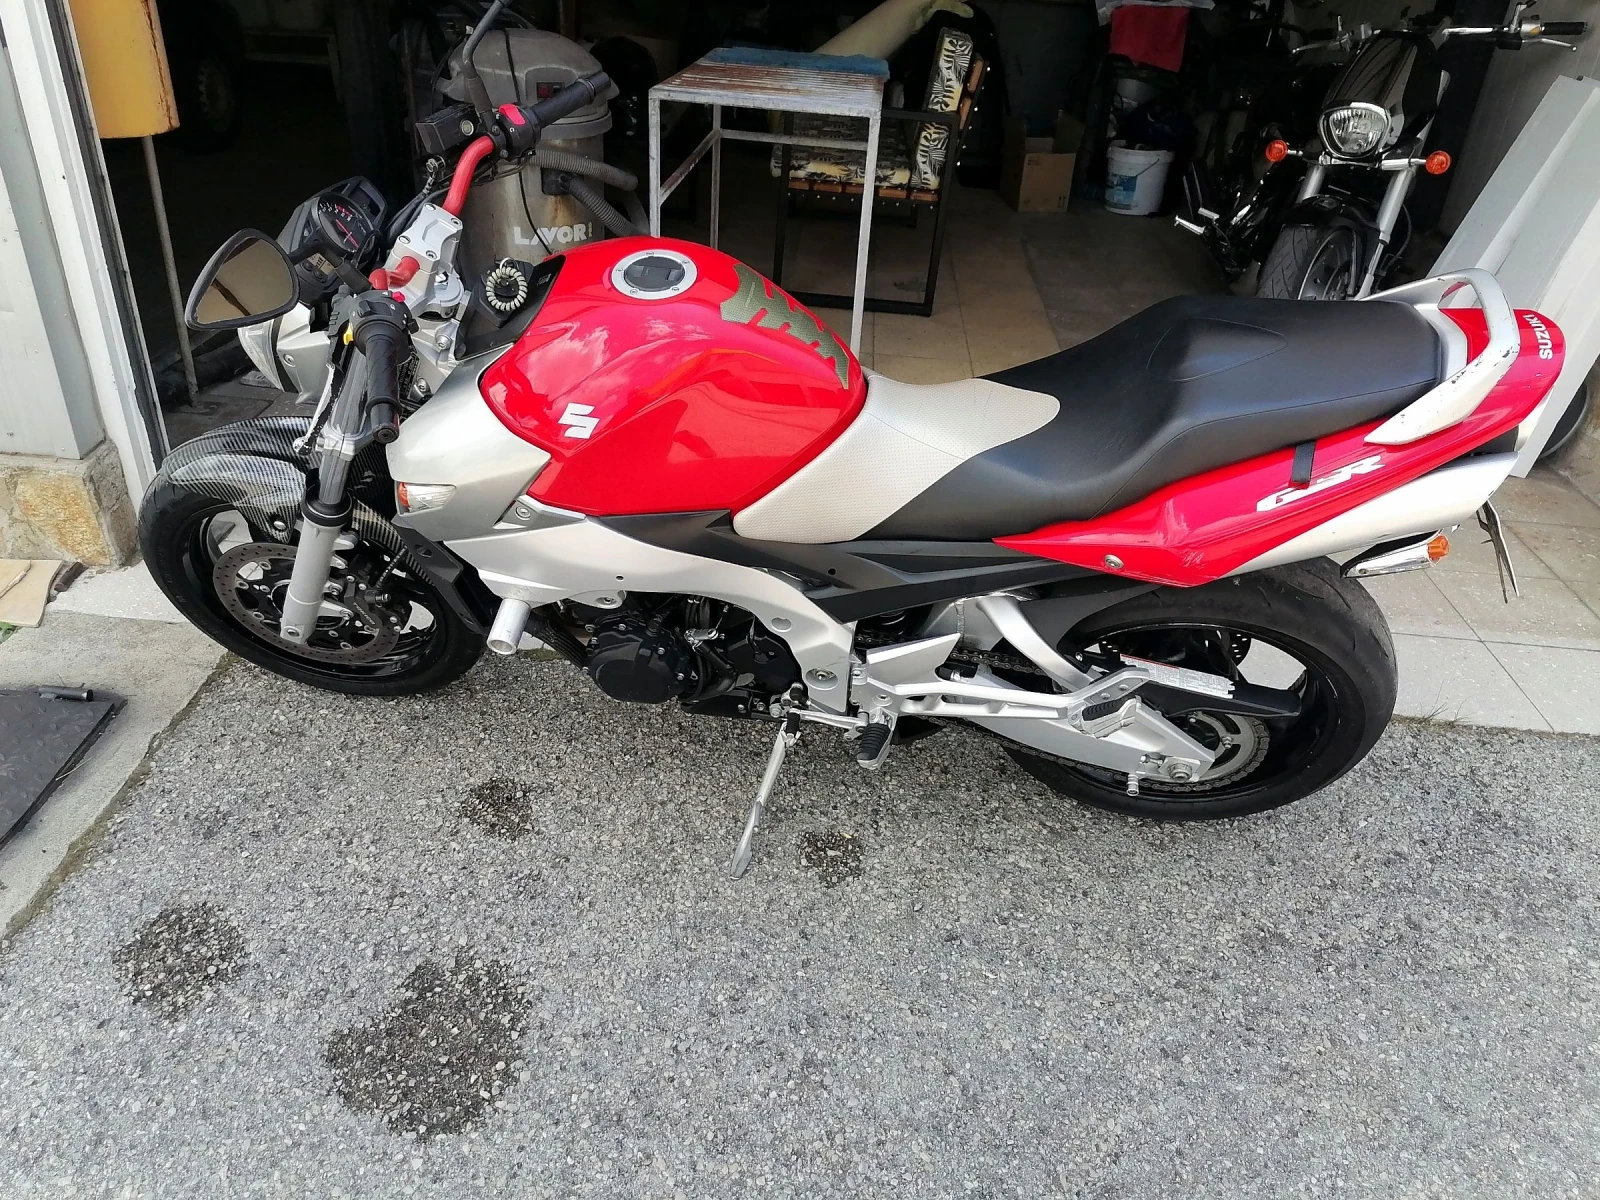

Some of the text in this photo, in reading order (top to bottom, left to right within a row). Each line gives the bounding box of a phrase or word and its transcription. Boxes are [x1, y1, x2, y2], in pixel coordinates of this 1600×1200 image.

[513, 223, 587, 246] LAVOR
[1522, 314, 1554, 360] SUZUKI
[1256, 454, 1386, 512] GSR
